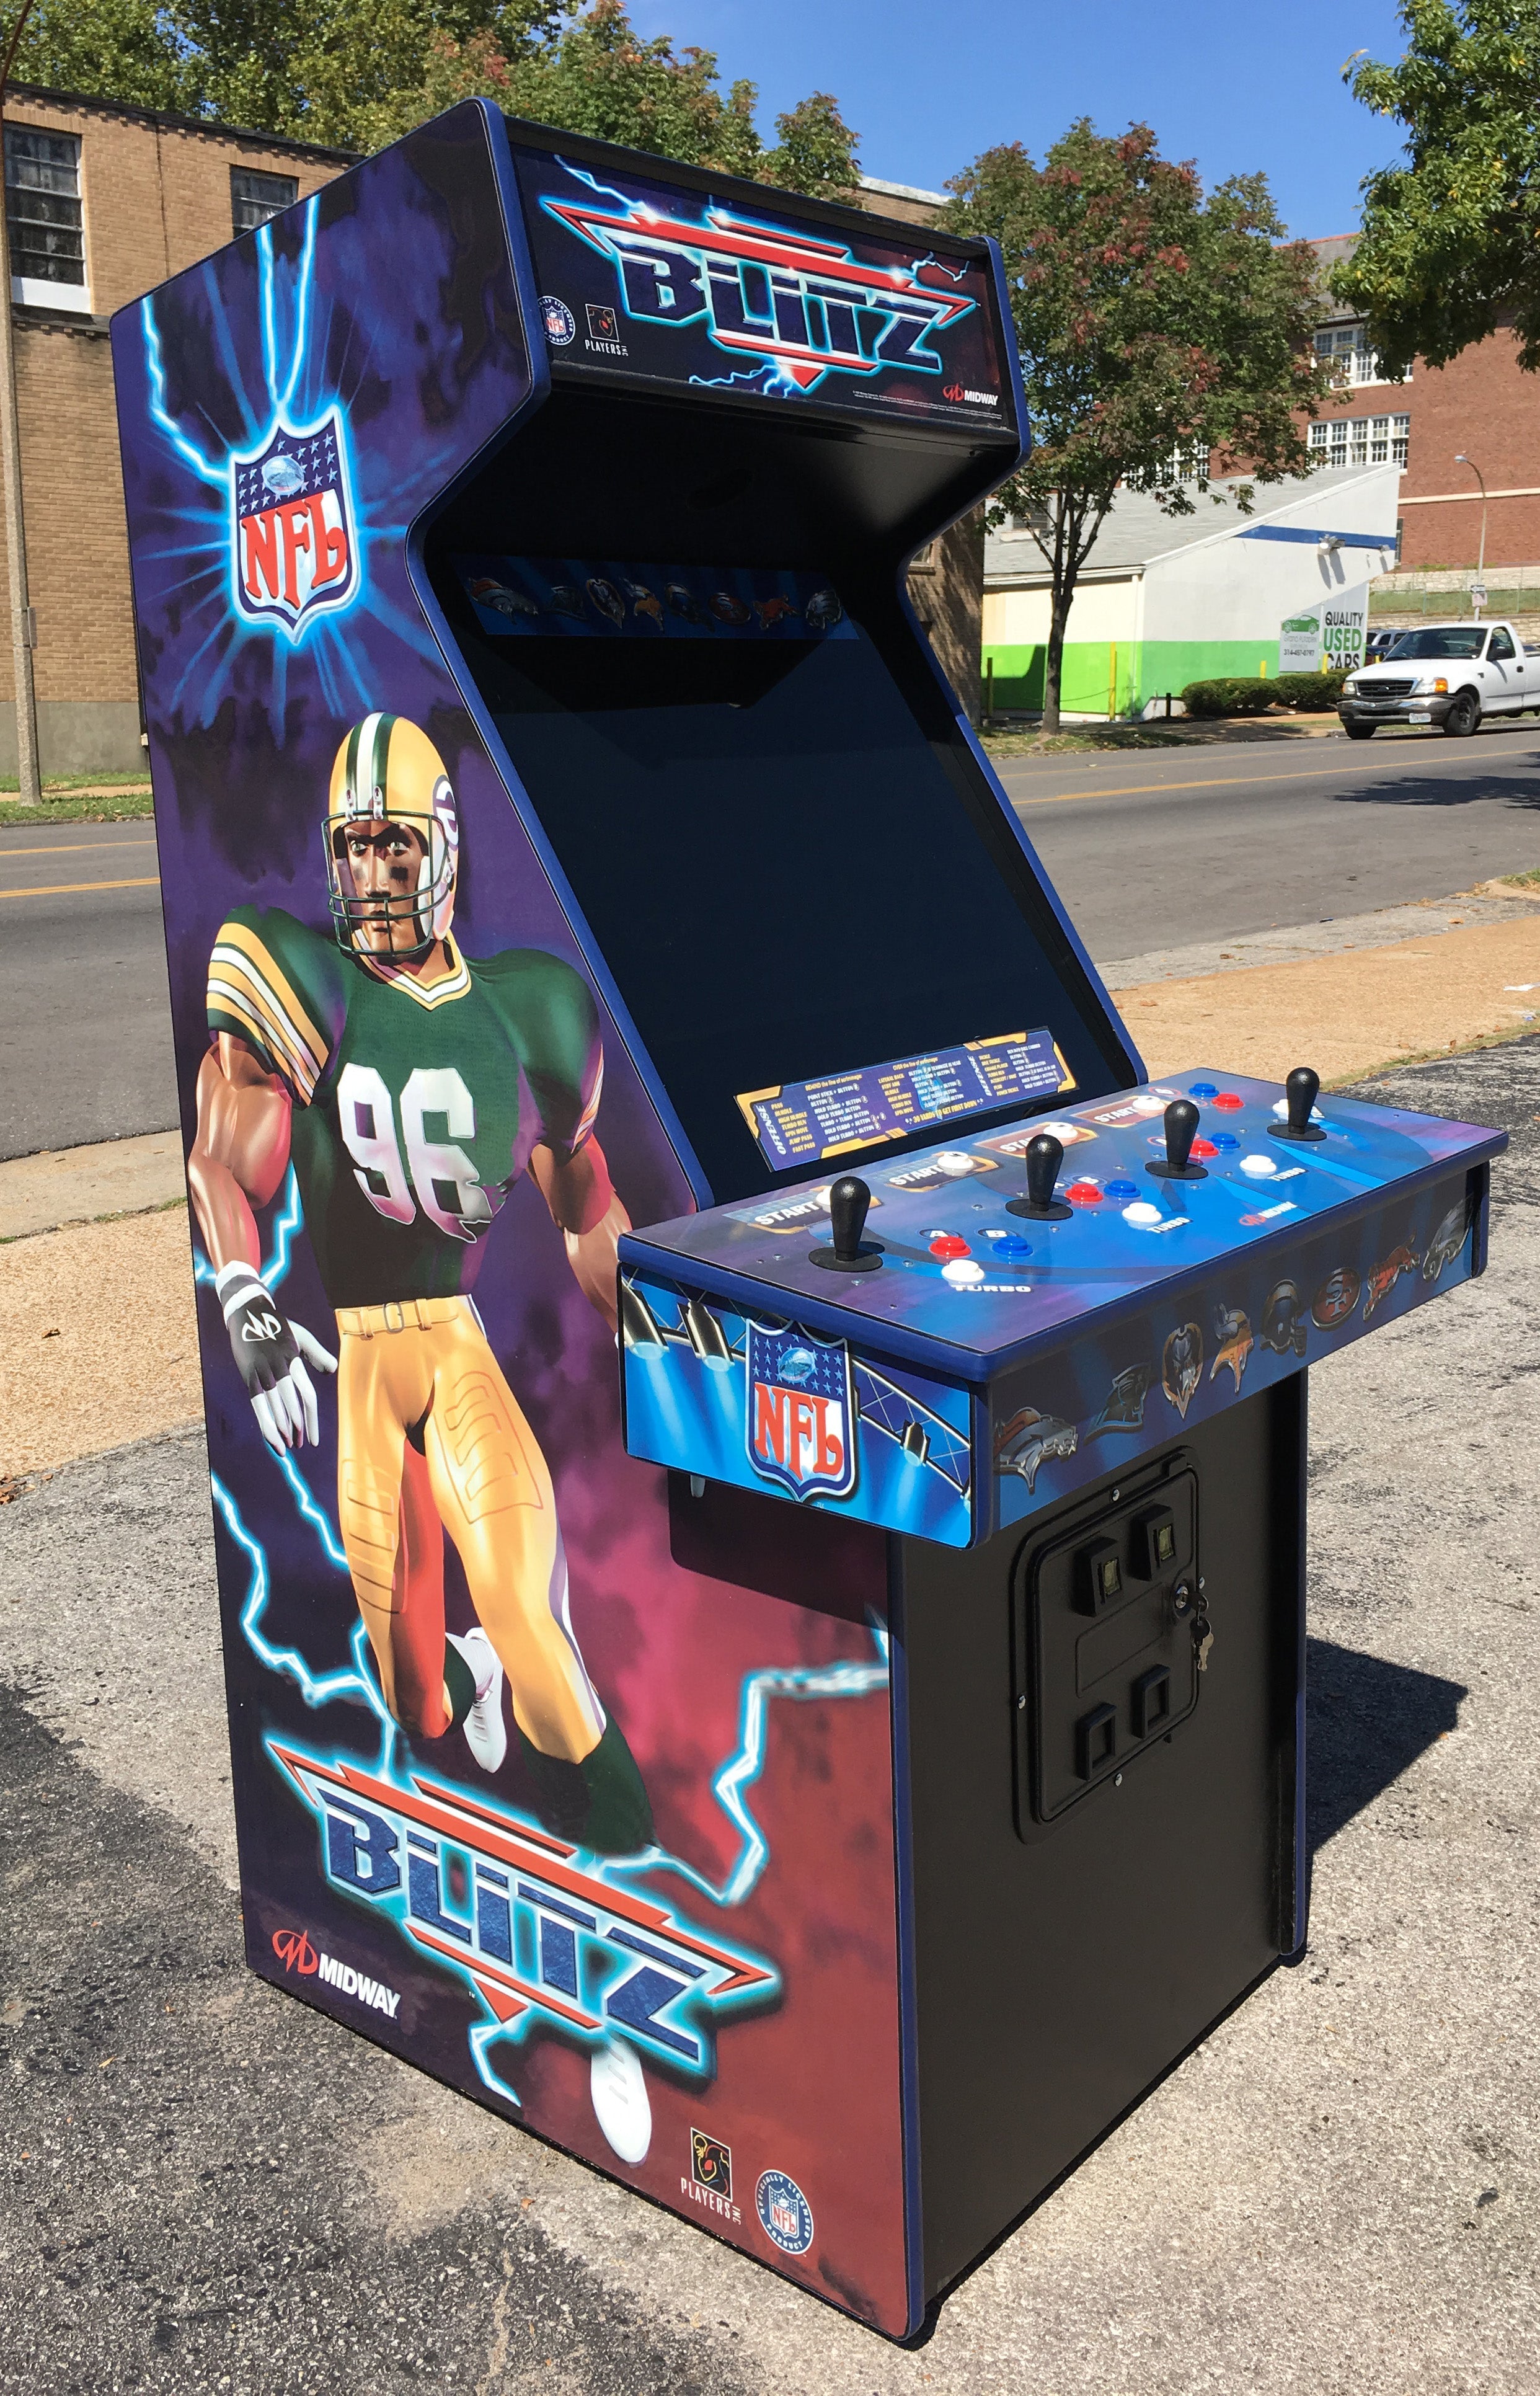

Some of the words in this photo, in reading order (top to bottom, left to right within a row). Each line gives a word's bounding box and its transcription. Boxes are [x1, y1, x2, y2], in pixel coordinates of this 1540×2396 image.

[614, 245, 941, 371] BLITZ
[546, 317, 564, 333] NFL
[585, 339, 621, 355] PLAYERS
[621, 345, 629, 357] INC
[965, 390, 998, 406] MIDWAY
[241, 492, 347, 610] NFL
[1325, 611, 1363, 626] QUALITY
[1324, 628, 1362, 652] USED
[837, 1085, 853, 1093] BUTTON
[810, 1099, 827, 1107] BUTTON
[826, 1103, 841, 1111] TURBO
[830, 1109, 844, 1117] TURBO
[844, 1105, 861, 1113] BUTTON
[934, 1109, 942, 1117] TO
[942, 1106, 951, 1114] GET
[950, 1103, 963, 1112] FIRST
[963, 1100, 977, 1108] DOWN
[853, 1110, 869, 1118] BUTTON
[854, 1117, 870, 1126] BUTTON
[1094, 1106, 1139, 1123] START
[756, 1106, 785, 1154] OFFENSE
[828, 1134, 839, 1142] HOLD
[858, 1125, 874, 1133] BUTTON
[338, 1062, 492, 1241] 96
[889, 1165, 944, 1186] START
[1267, 1167, 1307, 1181] TURBO
[755, 1201, 820, 1225] START
[929, 1230, 949, 1238] A
[987, 1230, 1009, 1238] B
[1146, 1217, 1191, 1234] TURBO
[950, 1285, 1032, 1293] TURBO
[755, 1382, 844, 1480] NFL
[316, 1787, 701, 2063] BLITZ
[318, 1953, 401, 2019] MIDWAY
[681, 2177, 730, 2219] PLAYERS
[732, 2206, 741, 2225] INC
[758, 2174, 784, 2215] OFFICIALLY
[772, 2205, 797, 2234] NFL
[788, 2183, 810, 2239] LICENSED
[766, 2223, 803, 2250] PRODUCT
